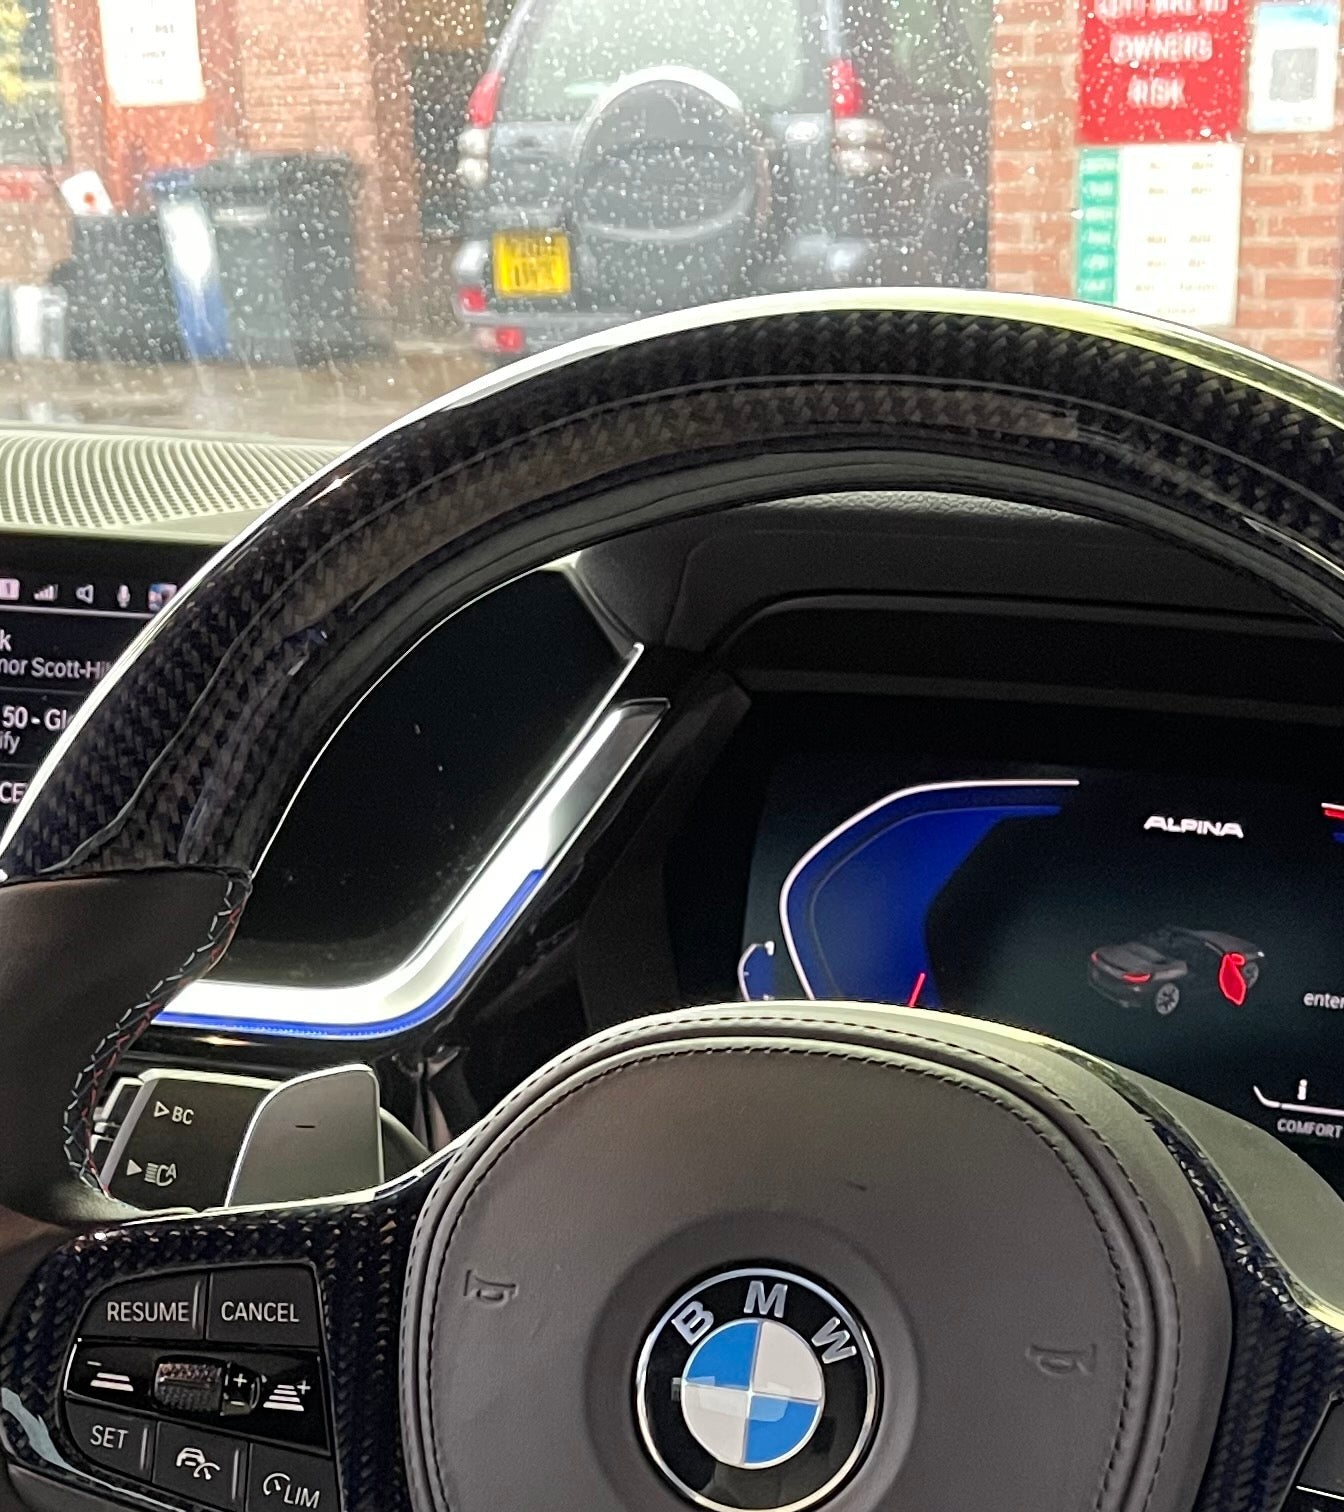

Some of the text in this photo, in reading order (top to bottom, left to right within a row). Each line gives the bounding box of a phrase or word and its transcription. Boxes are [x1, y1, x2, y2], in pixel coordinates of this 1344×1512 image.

[1, 705, 29, 729] 50
[1144, 816, 1244, 839] ALPINA
[172, 1106, 195, 1125] BC
[1277, 1118, 1343, 1139] COMFORT
[107, 1301, 190, 1323] RESUME
[220, 1301, 300, 1323] CANCEL
[671, 1280, 857, 1364] BMW
[90, 1425, 128, 1450] SET
[284, 1484, 321, 1508] LIM
